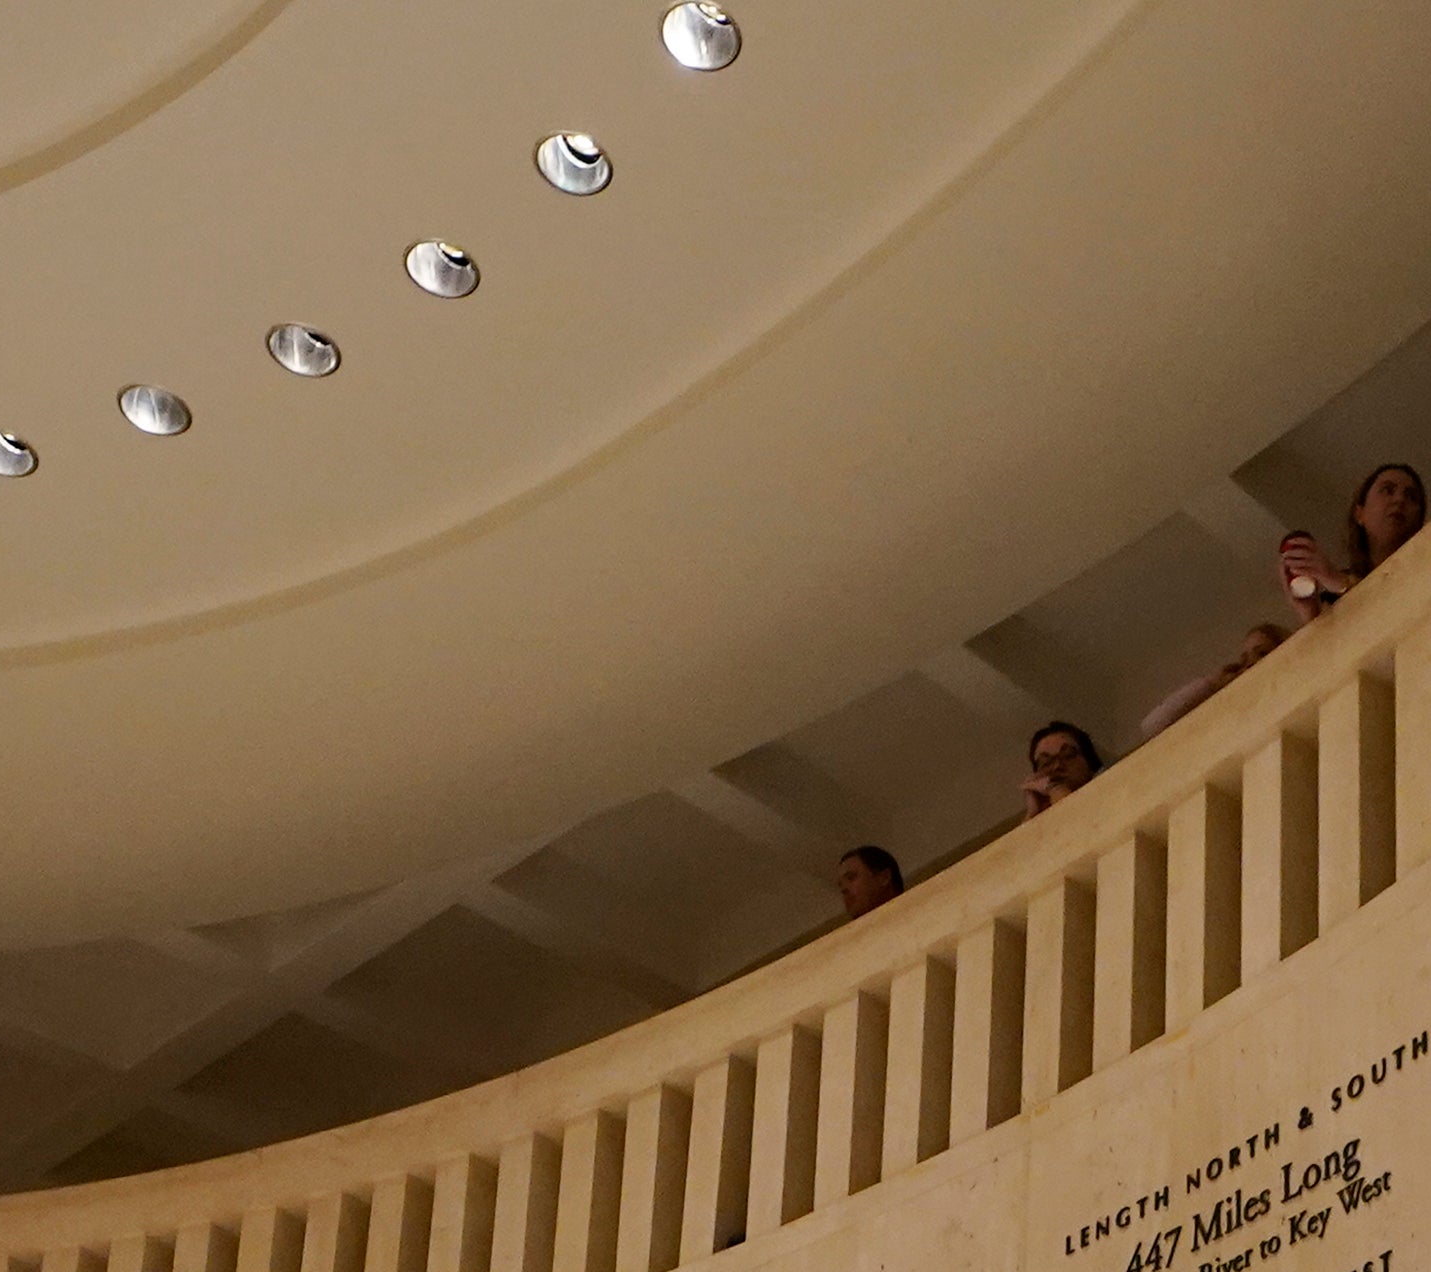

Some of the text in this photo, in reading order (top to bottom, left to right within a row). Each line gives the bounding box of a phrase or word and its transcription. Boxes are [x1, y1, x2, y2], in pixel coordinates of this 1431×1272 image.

[1065, 1031, 1429, 1256] LENGTH NORTH & SOUTH
[1191, 1188, 1271, 1252] Miles
[1281, 1138, 1361, 1203] Long
[1260, 1233, 1281, 1257] to
[1288, 1206, 1332, 1245] Key
[1336, 1171, 1392, 1215] West
